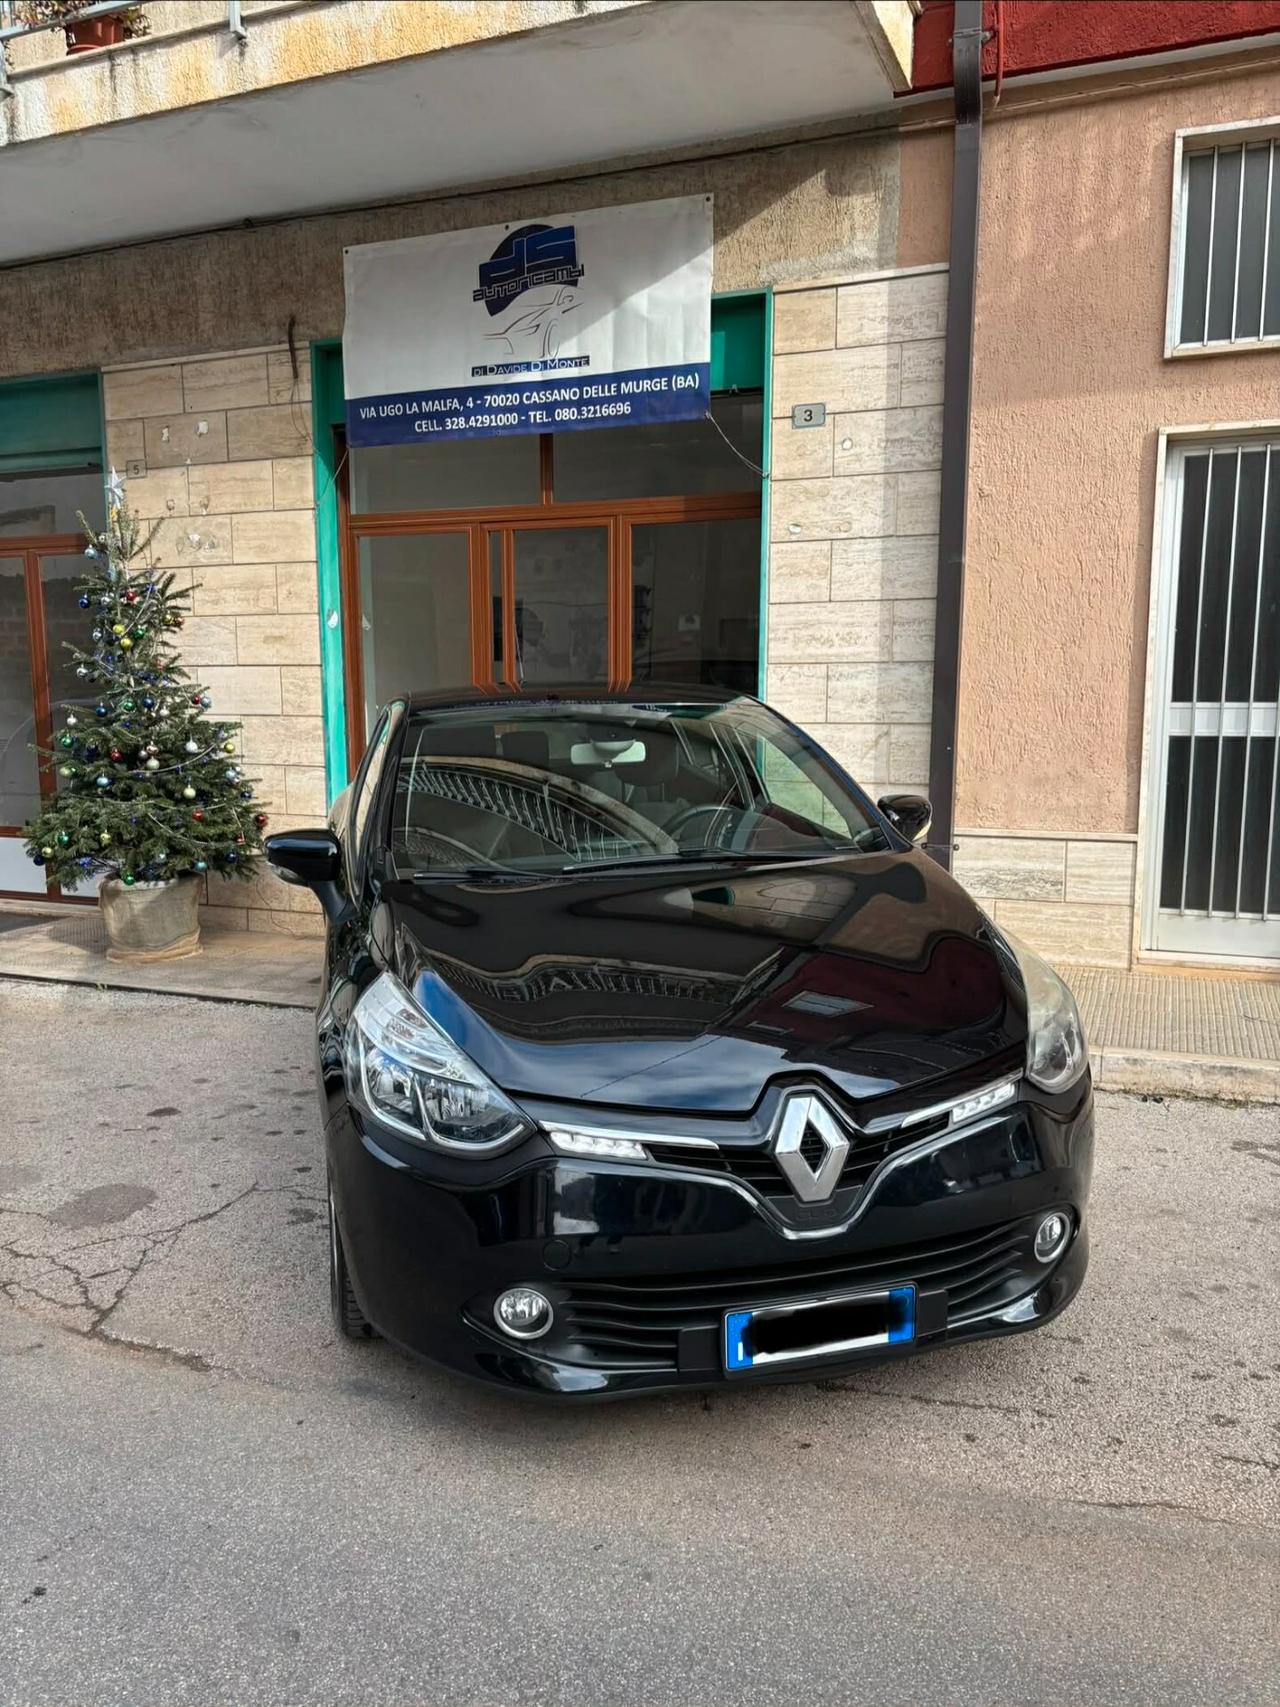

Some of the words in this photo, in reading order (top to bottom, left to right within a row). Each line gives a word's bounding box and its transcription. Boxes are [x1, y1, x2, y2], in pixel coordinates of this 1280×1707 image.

[360, 408, 376, 419] VIA
[379, 404, 403, 417] UGO
[406, 403, 419, 414] LA
[422, 398, 463, 413] MALFA,
[466, 397, 474, 408] 4
[484, 393, 519, 407] 70020
[523, 388, 580, 404] CASSANO
[583, 383, 617, 398] DELLE
[621, 377, 668, 394] MURGE
[672, 372, 699, 392] (BA)
[415, 420, 442, 432] CELL.
[445, 413, 518, 430] 328.4291000
[529, 411, 551, 423] TEL.
[555, 402, 631, 421] 080.3216696
[803, 409, 813, 422] 3
[133, 464, 140, 475] 5
